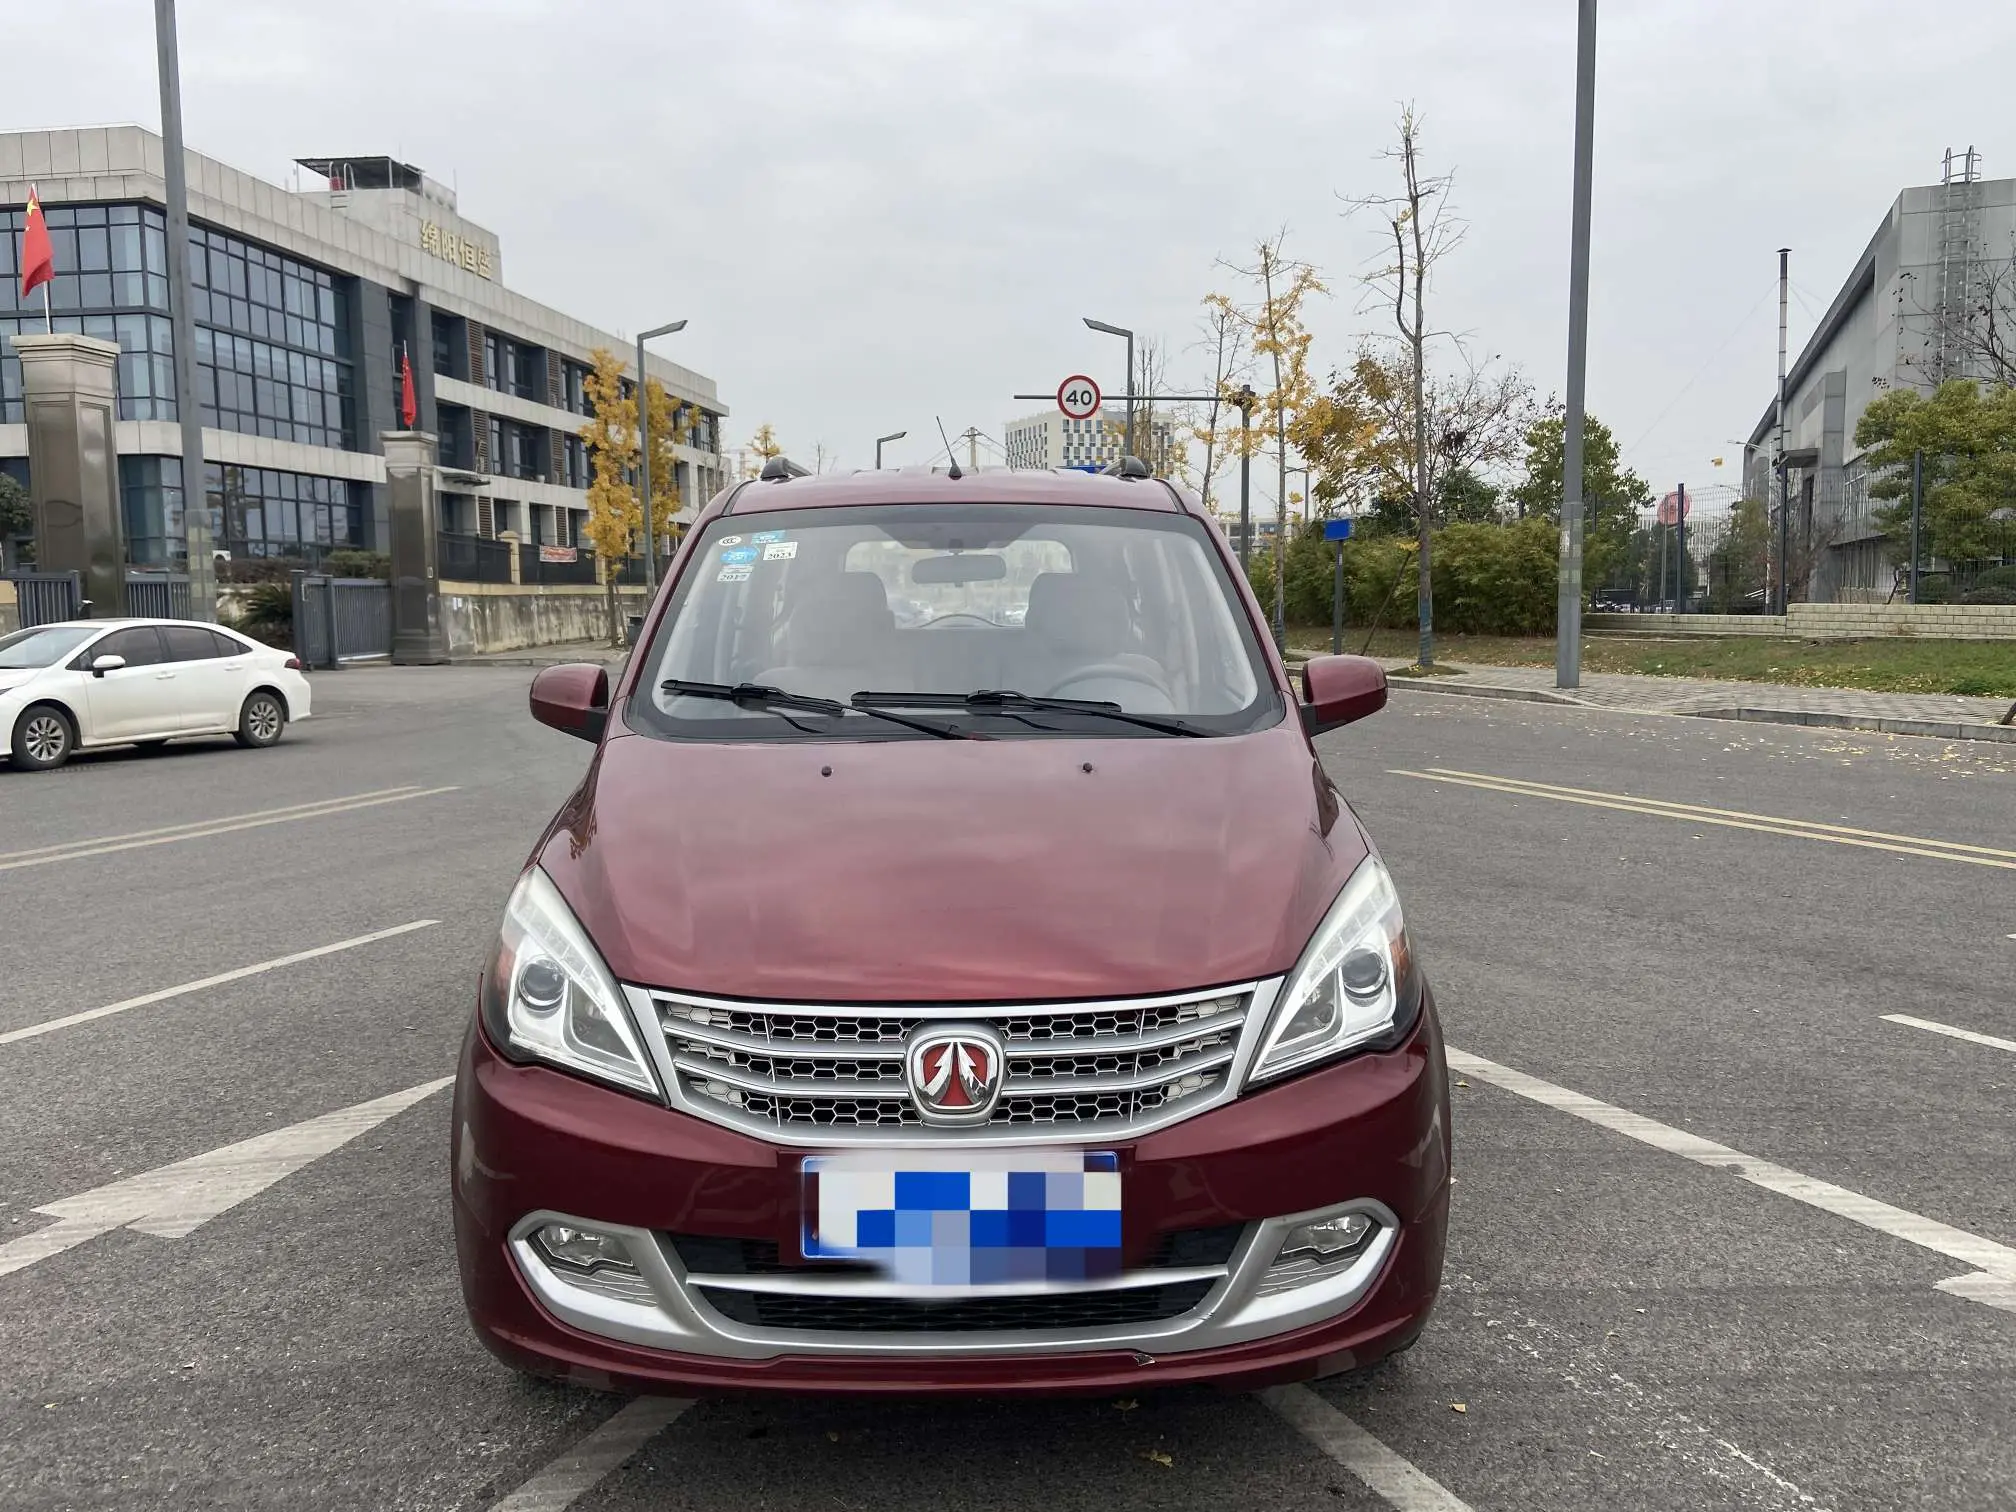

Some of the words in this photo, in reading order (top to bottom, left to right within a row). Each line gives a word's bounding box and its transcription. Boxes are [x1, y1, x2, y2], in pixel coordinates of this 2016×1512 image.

[421, 220, 491, 279] 绵阳恒盛
[1065, 390, 1092, 406] 40
